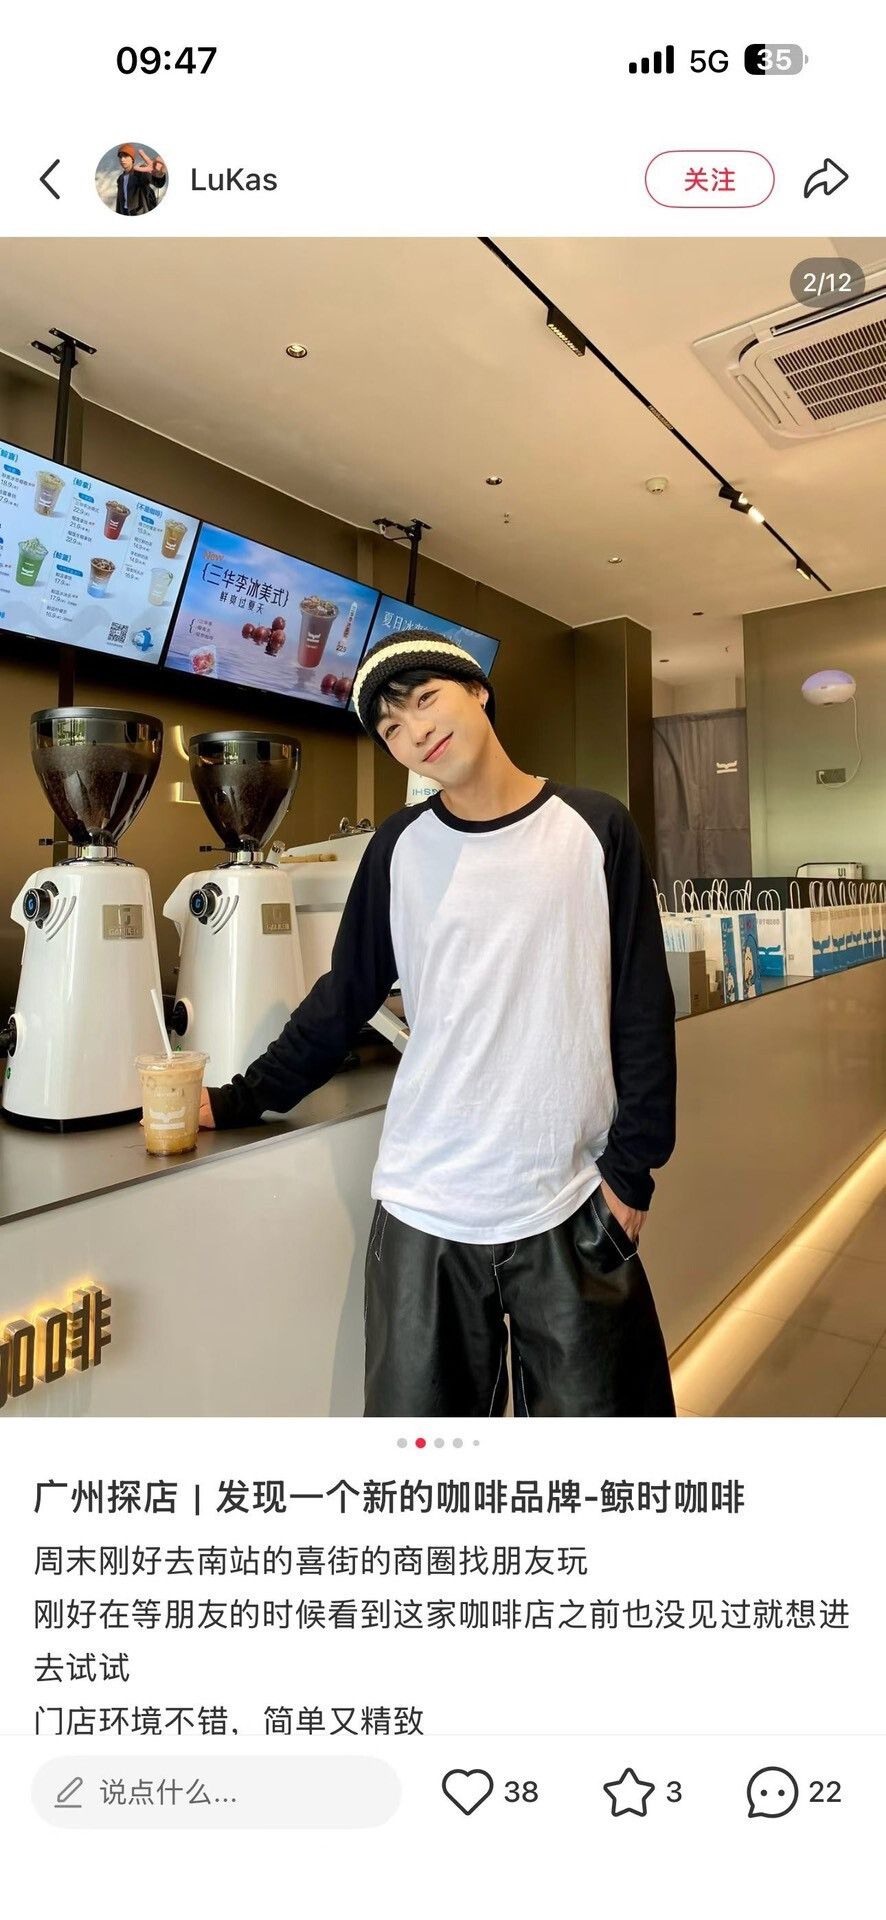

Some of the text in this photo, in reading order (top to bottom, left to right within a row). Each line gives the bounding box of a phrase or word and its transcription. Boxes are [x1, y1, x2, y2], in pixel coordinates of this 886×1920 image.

[220, 590, 265, 615] 鲜爽过夏天
